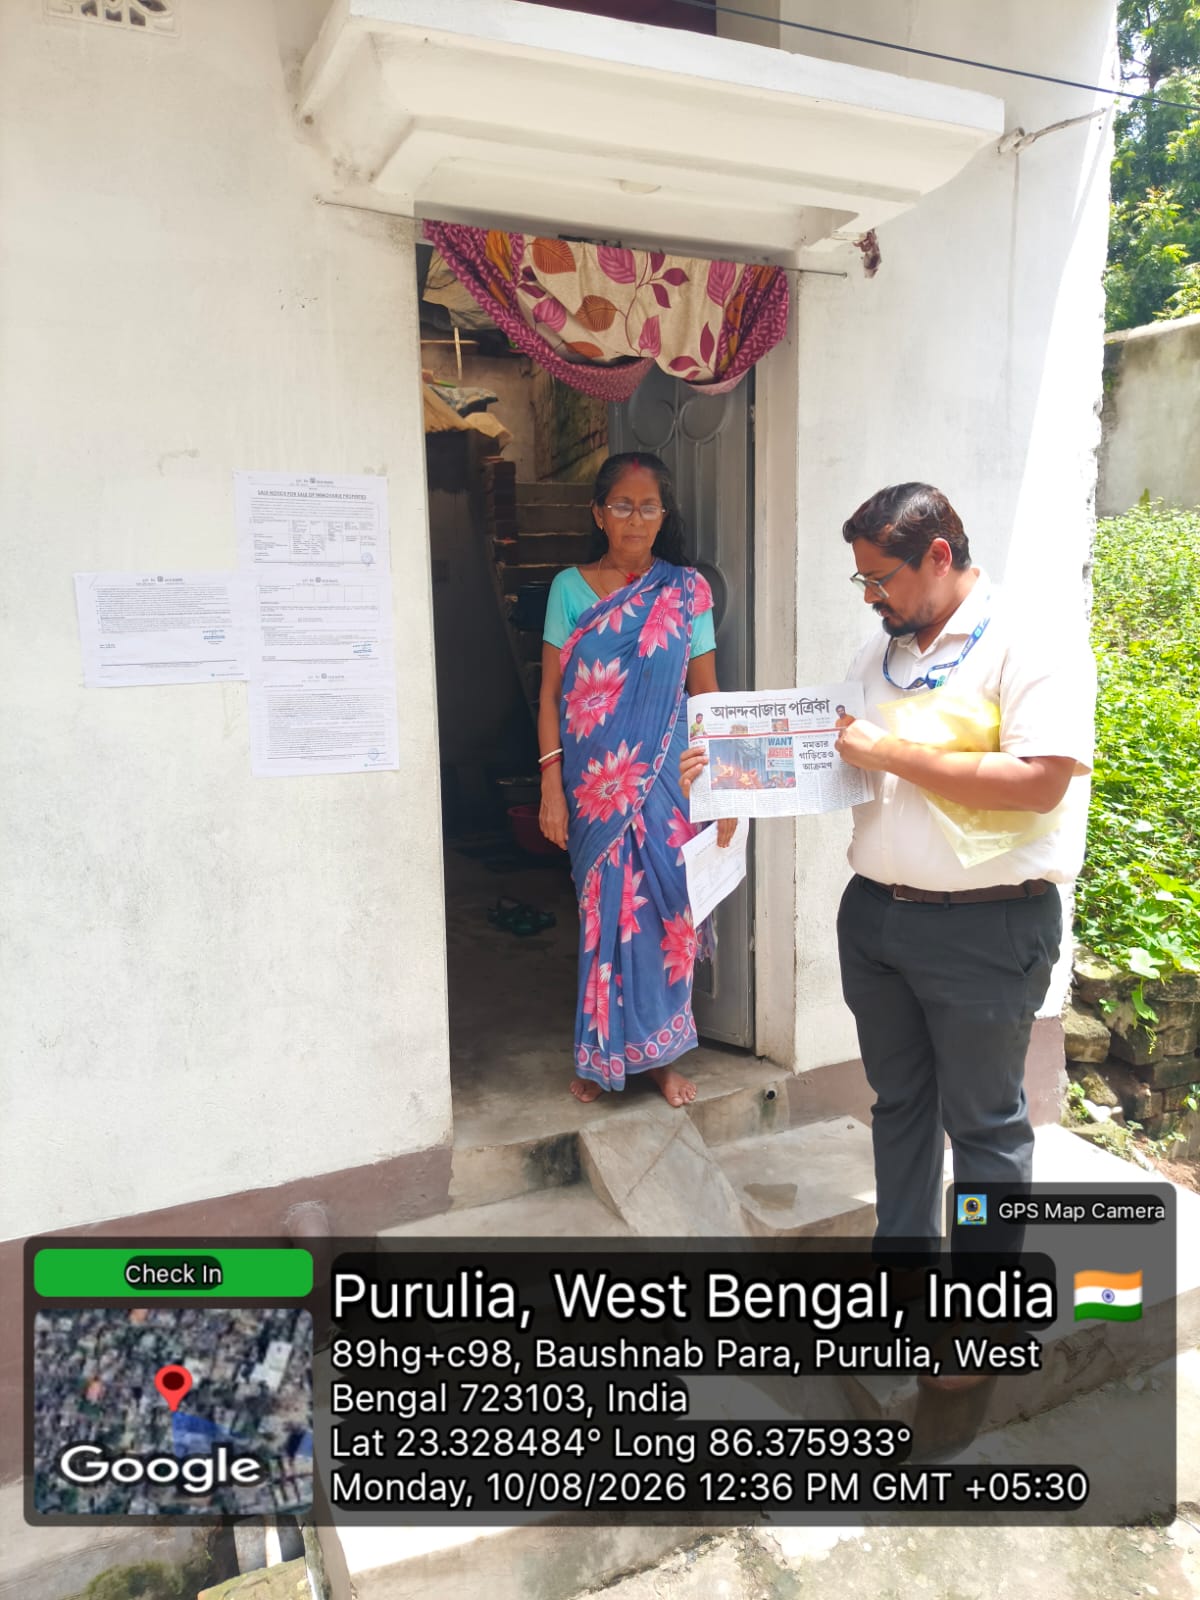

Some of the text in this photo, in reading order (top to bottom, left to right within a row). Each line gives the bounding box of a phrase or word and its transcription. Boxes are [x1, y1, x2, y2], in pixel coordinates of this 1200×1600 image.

[710, 697, 830, 719] আনন্দবাজার পত্রিকা
[768, 736, 793, 746] WANT
